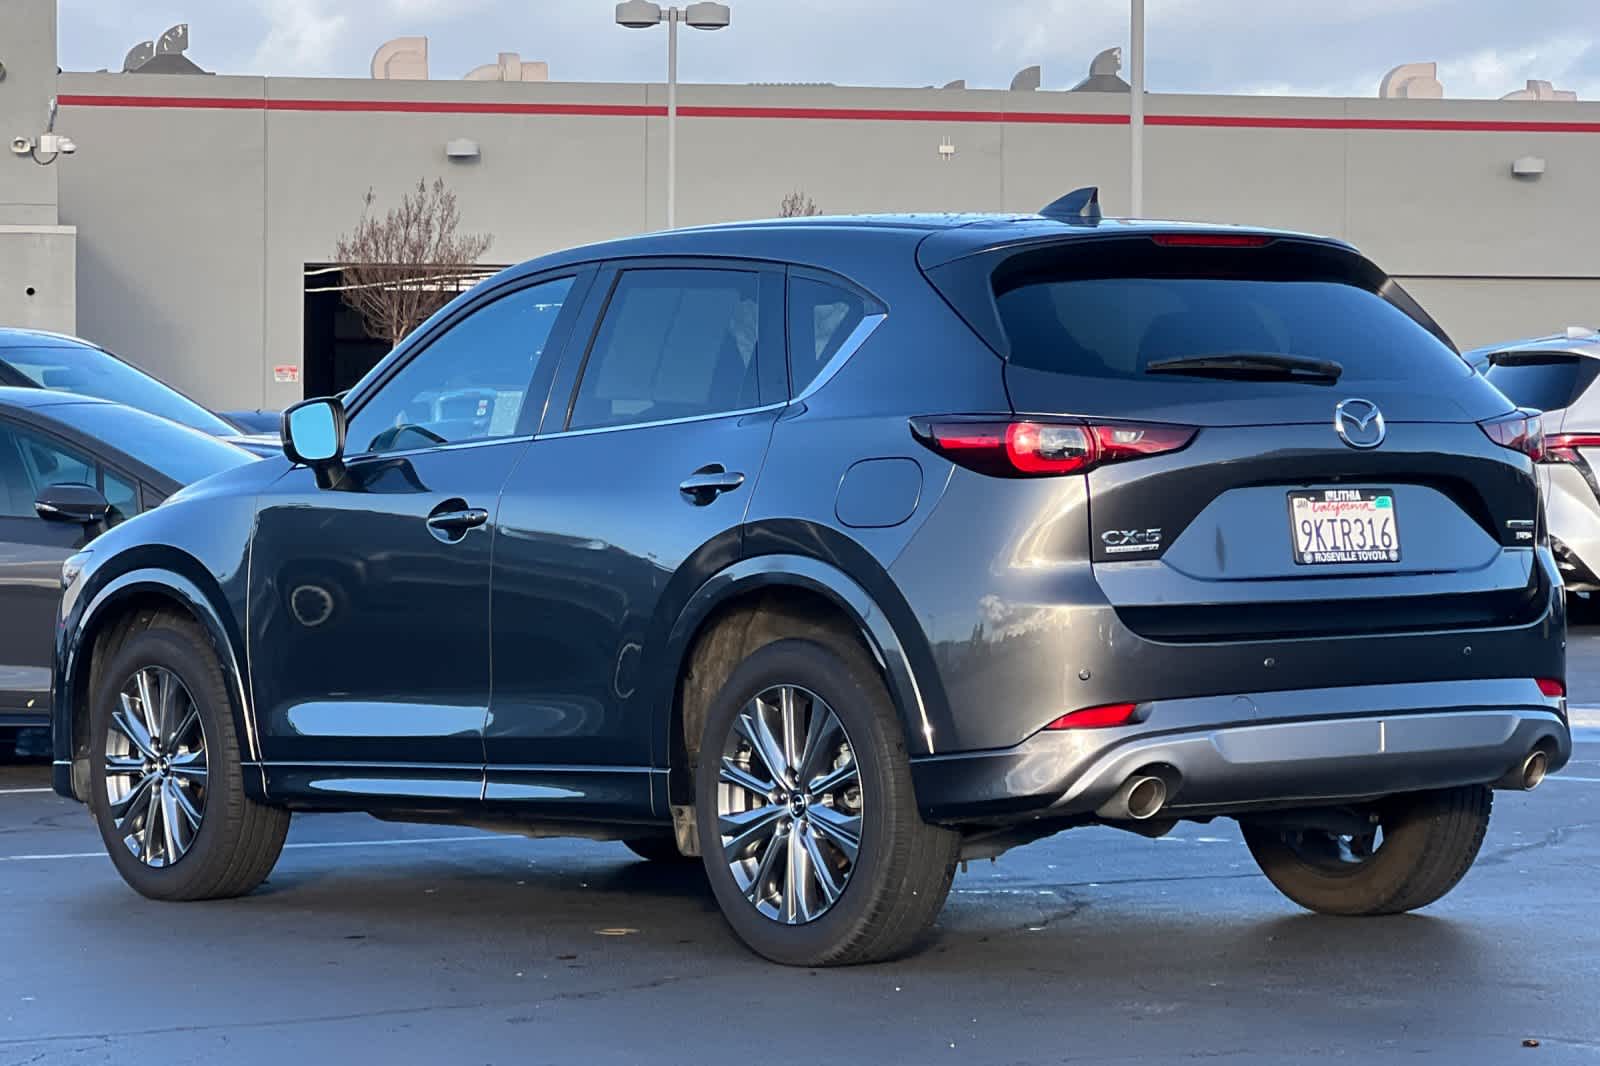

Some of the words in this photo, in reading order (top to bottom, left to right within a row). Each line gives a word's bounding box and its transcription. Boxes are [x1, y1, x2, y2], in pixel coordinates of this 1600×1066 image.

[1334, 490, 1361, 501] LITHIA
[1311, 501, 1376, 516] California
[1101, 528, 1162, 544] CX-5
[1301, 517, 1392, 551] 9KIR316
[1315, 552, 1357, 562] ROSEVILLE
[1358, 551, 1388, 561] TOYOTA
